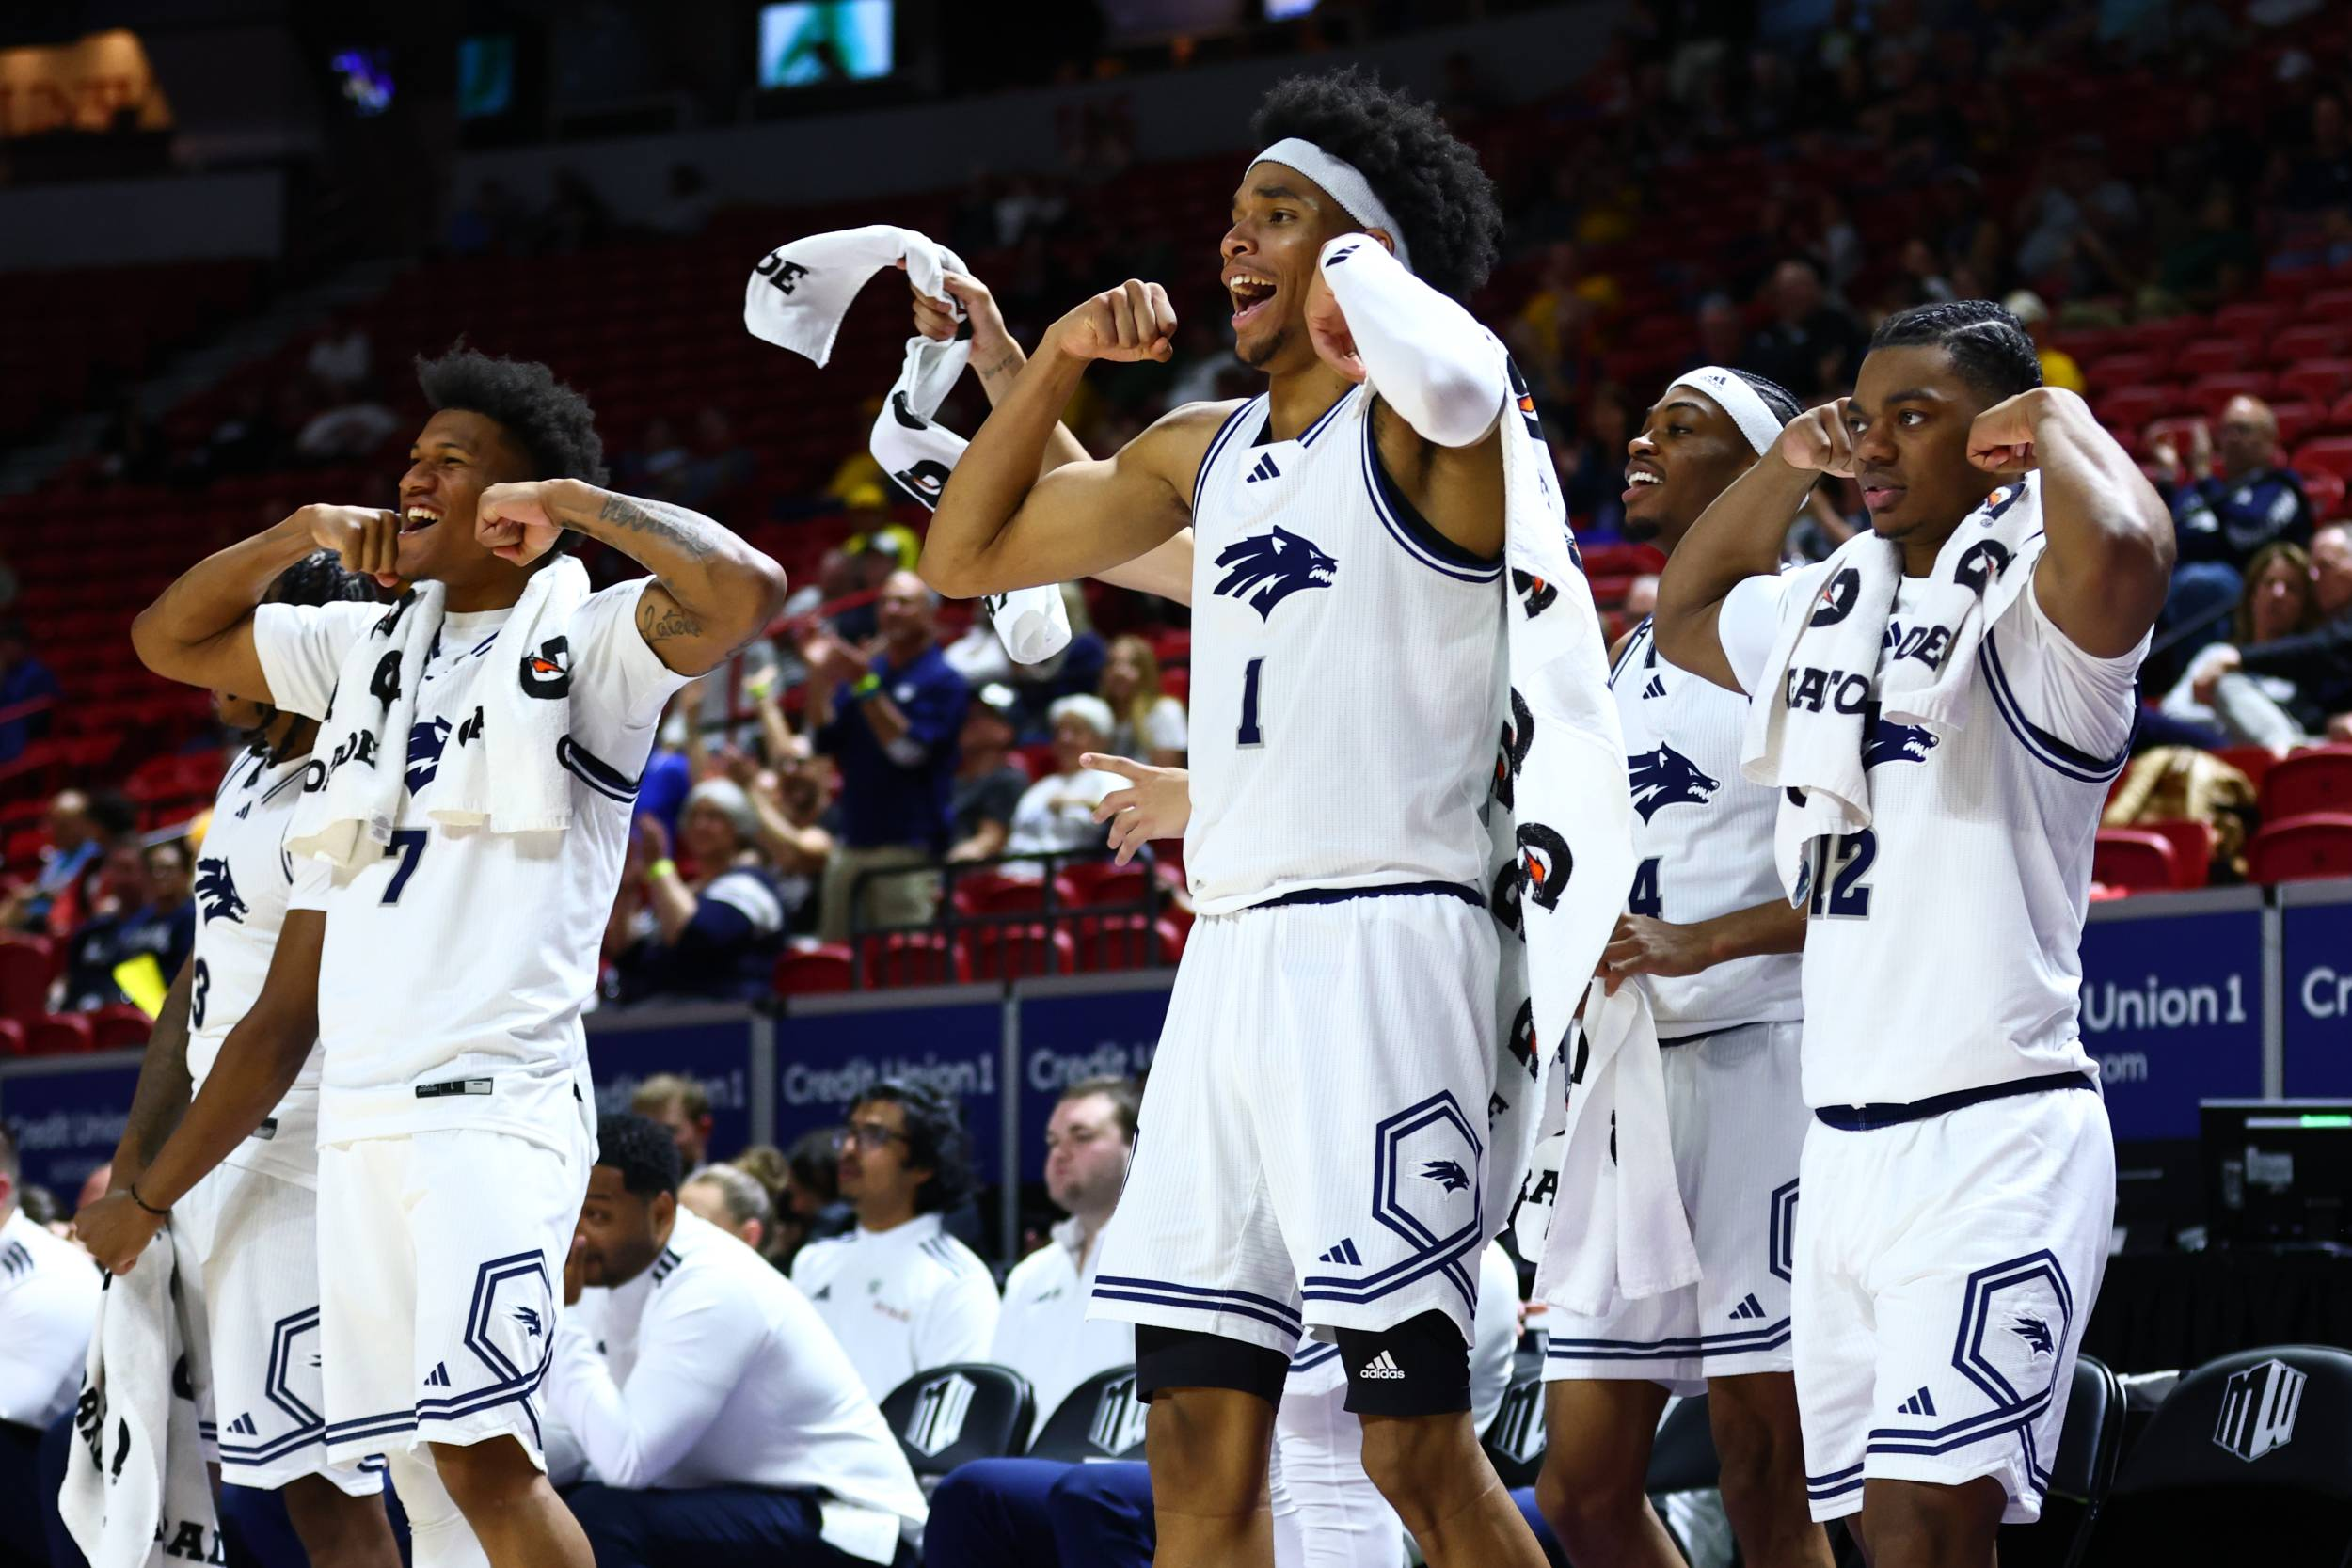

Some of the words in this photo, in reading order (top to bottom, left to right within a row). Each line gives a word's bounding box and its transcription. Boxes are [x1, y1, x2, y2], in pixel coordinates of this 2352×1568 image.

[1235, 656, 1266, 750] 1
[377, 827, 432, 908] 7
[1629, 855, 1664, 920] 4
[2083, 974, 2219, 1031] Union
[1360, 1367, 1406, 1379] adidas
